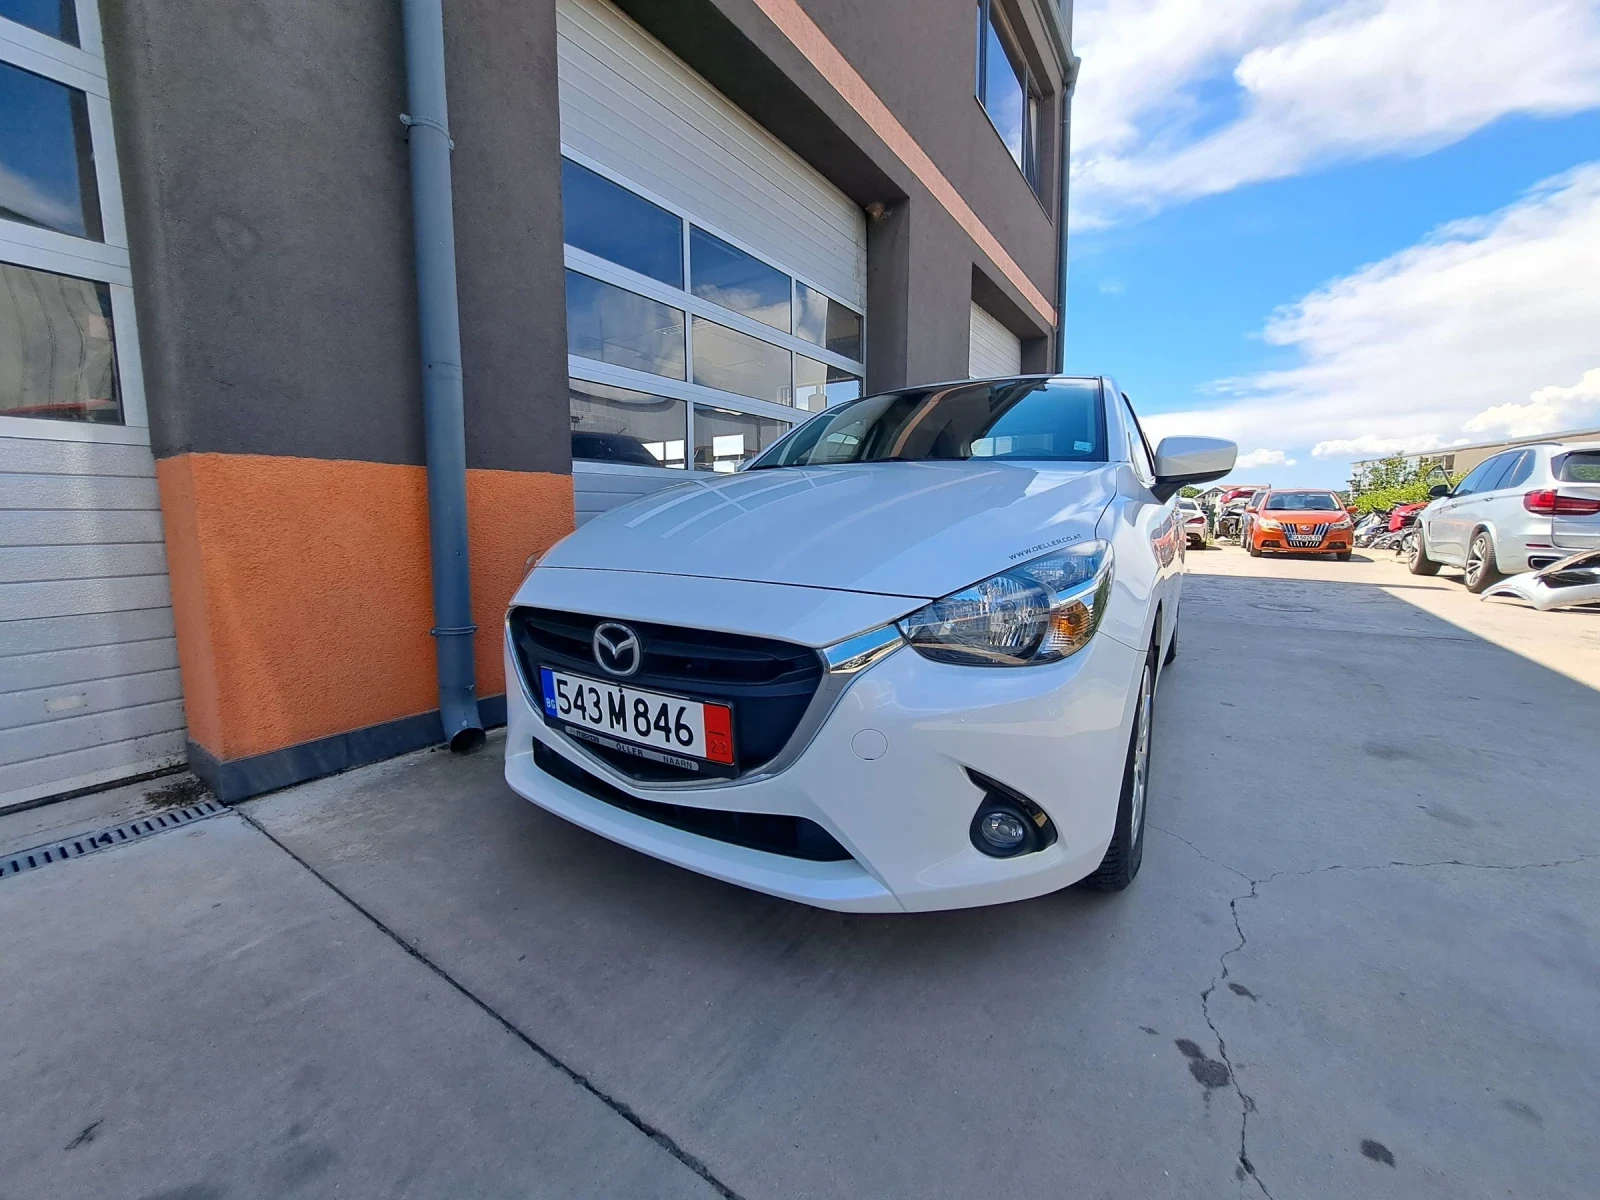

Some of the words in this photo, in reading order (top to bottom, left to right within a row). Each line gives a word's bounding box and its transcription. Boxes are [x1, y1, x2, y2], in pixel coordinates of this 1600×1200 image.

[546, 697, 557, 710] BG
[556, 678, 603, 724] 543
[633, 698, 694, 746] 846
[711, 739, 727, 755] 23
[663, 755, 693, 770] NAARN
